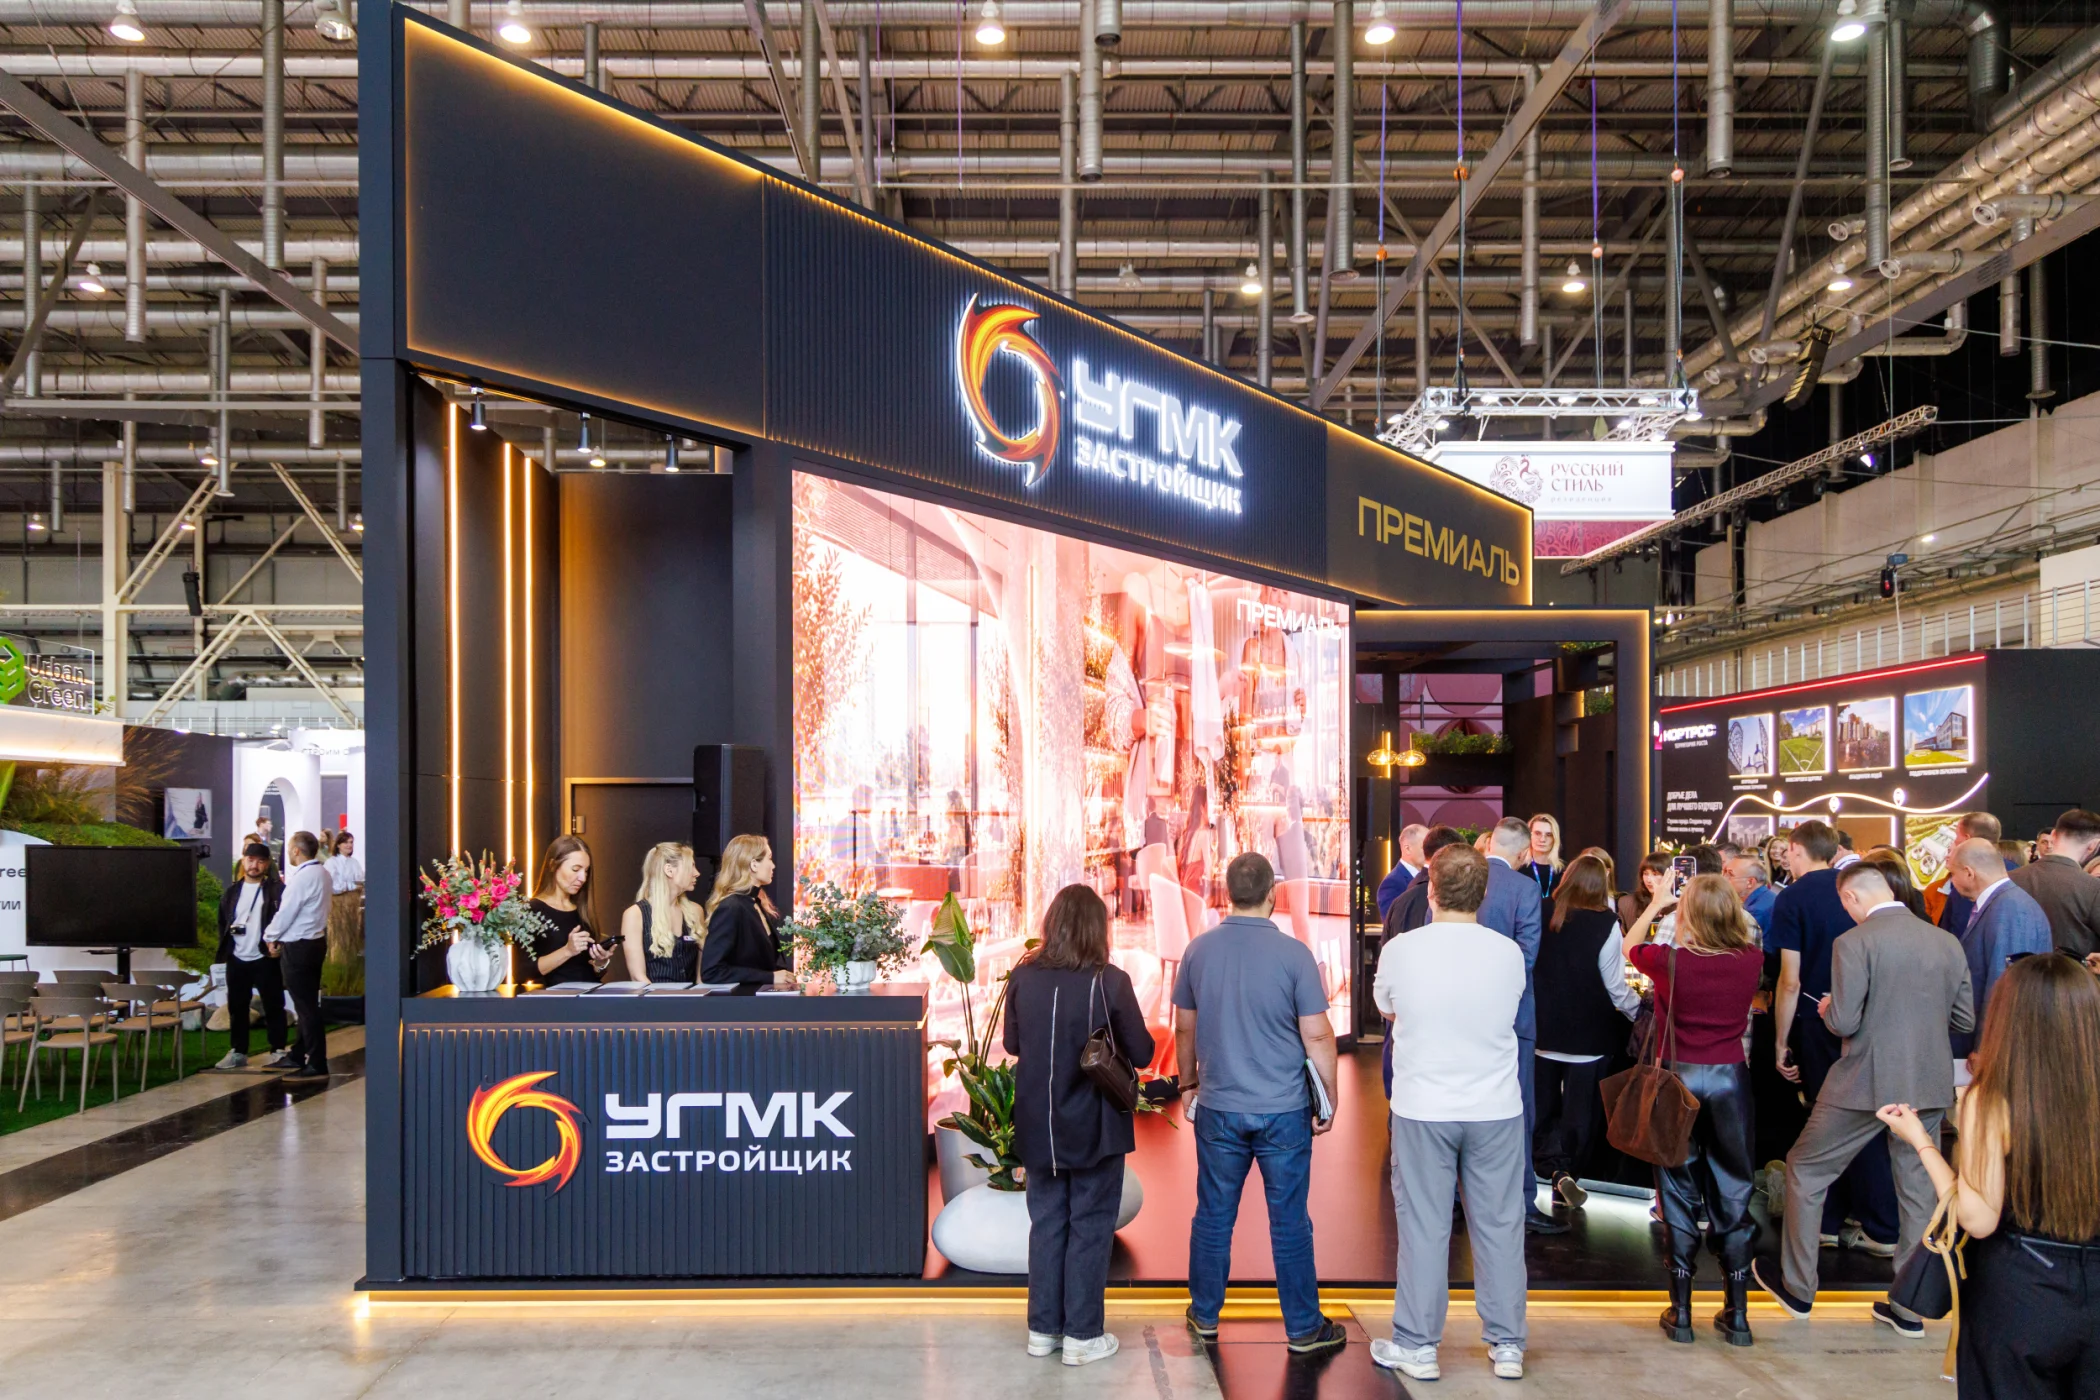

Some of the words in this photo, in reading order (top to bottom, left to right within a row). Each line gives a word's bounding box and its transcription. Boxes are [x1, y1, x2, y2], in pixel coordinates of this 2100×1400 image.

[1073, 358, 1244, 477] УГМК
[1076, 436, 1243, 514] ЗАСТРОЙЩИК
[1551, 461, 1623, 476] РУССКИЙ
[1551, 478, 1604, 492] СТИЛЬ
[1358, 496, 1521, 587] ПРЕМИАЛЬ
[1236, 598, 1342, 641] ПРЕМИАЛЬ
[26, 653, 87, 686] Urban
[28, 679, 87, 710] Green
[0, 900, 21, 911] ии
[605, 1092, 856, 1139] УГМК
[605, 1145, 852, 1175] ЗАСТРОЙЩИК
